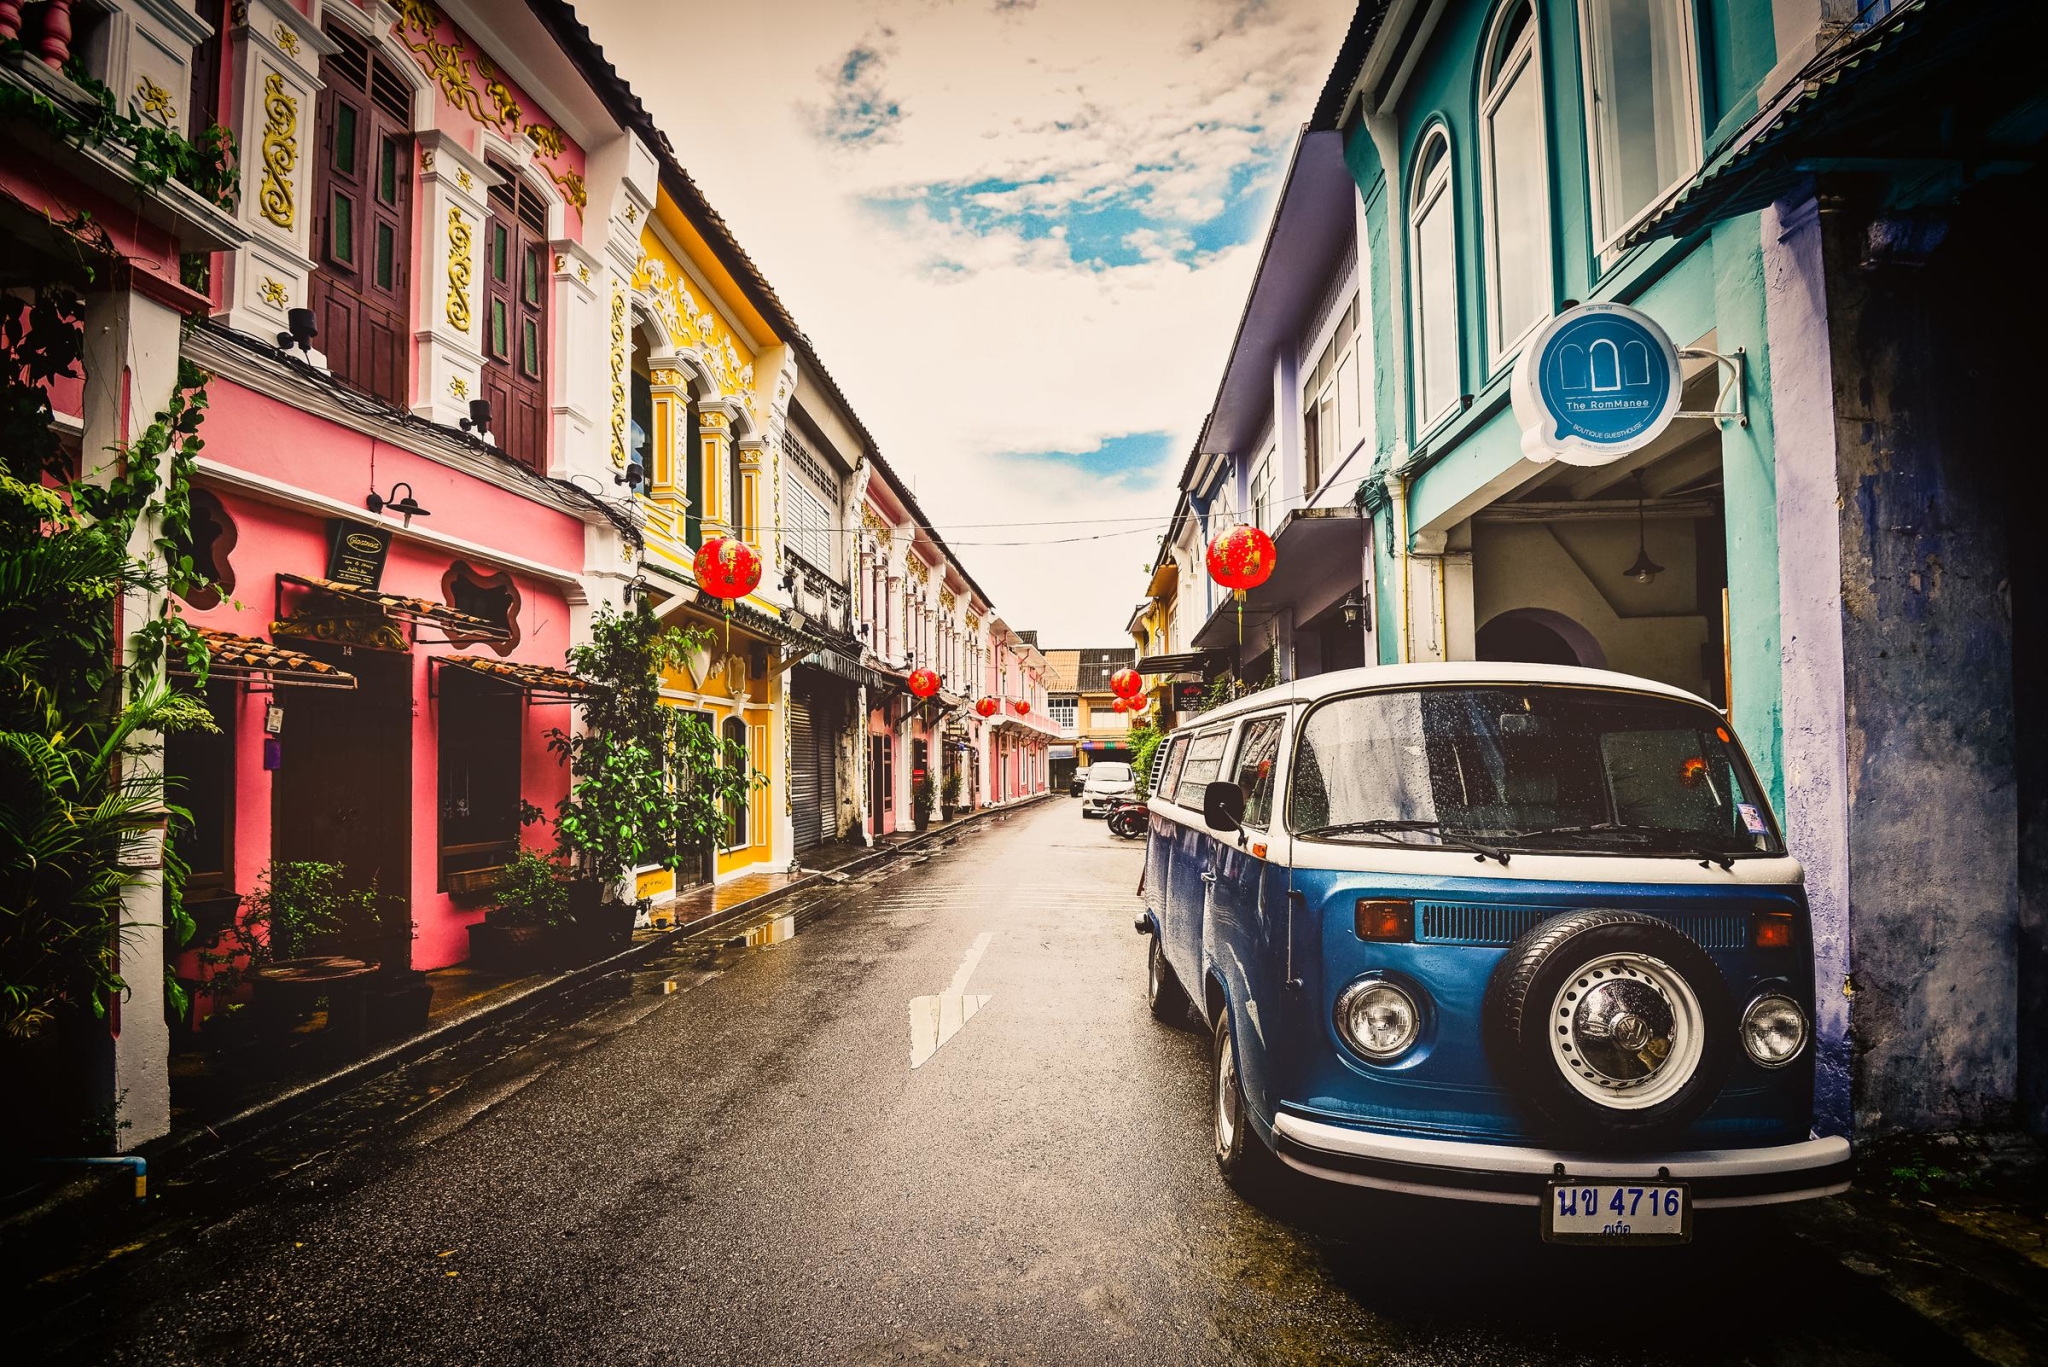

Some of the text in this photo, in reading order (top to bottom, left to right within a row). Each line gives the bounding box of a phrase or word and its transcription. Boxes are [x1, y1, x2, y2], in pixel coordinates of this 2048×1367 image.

[1566, 400, 1650, 411] The RomManee
[1573, 421, 1644, 439] BOUTIQUE GUESTHOUSE
[342, 645, 353, 656] 14
[1609, 1188, 1680, 1217] 4716
